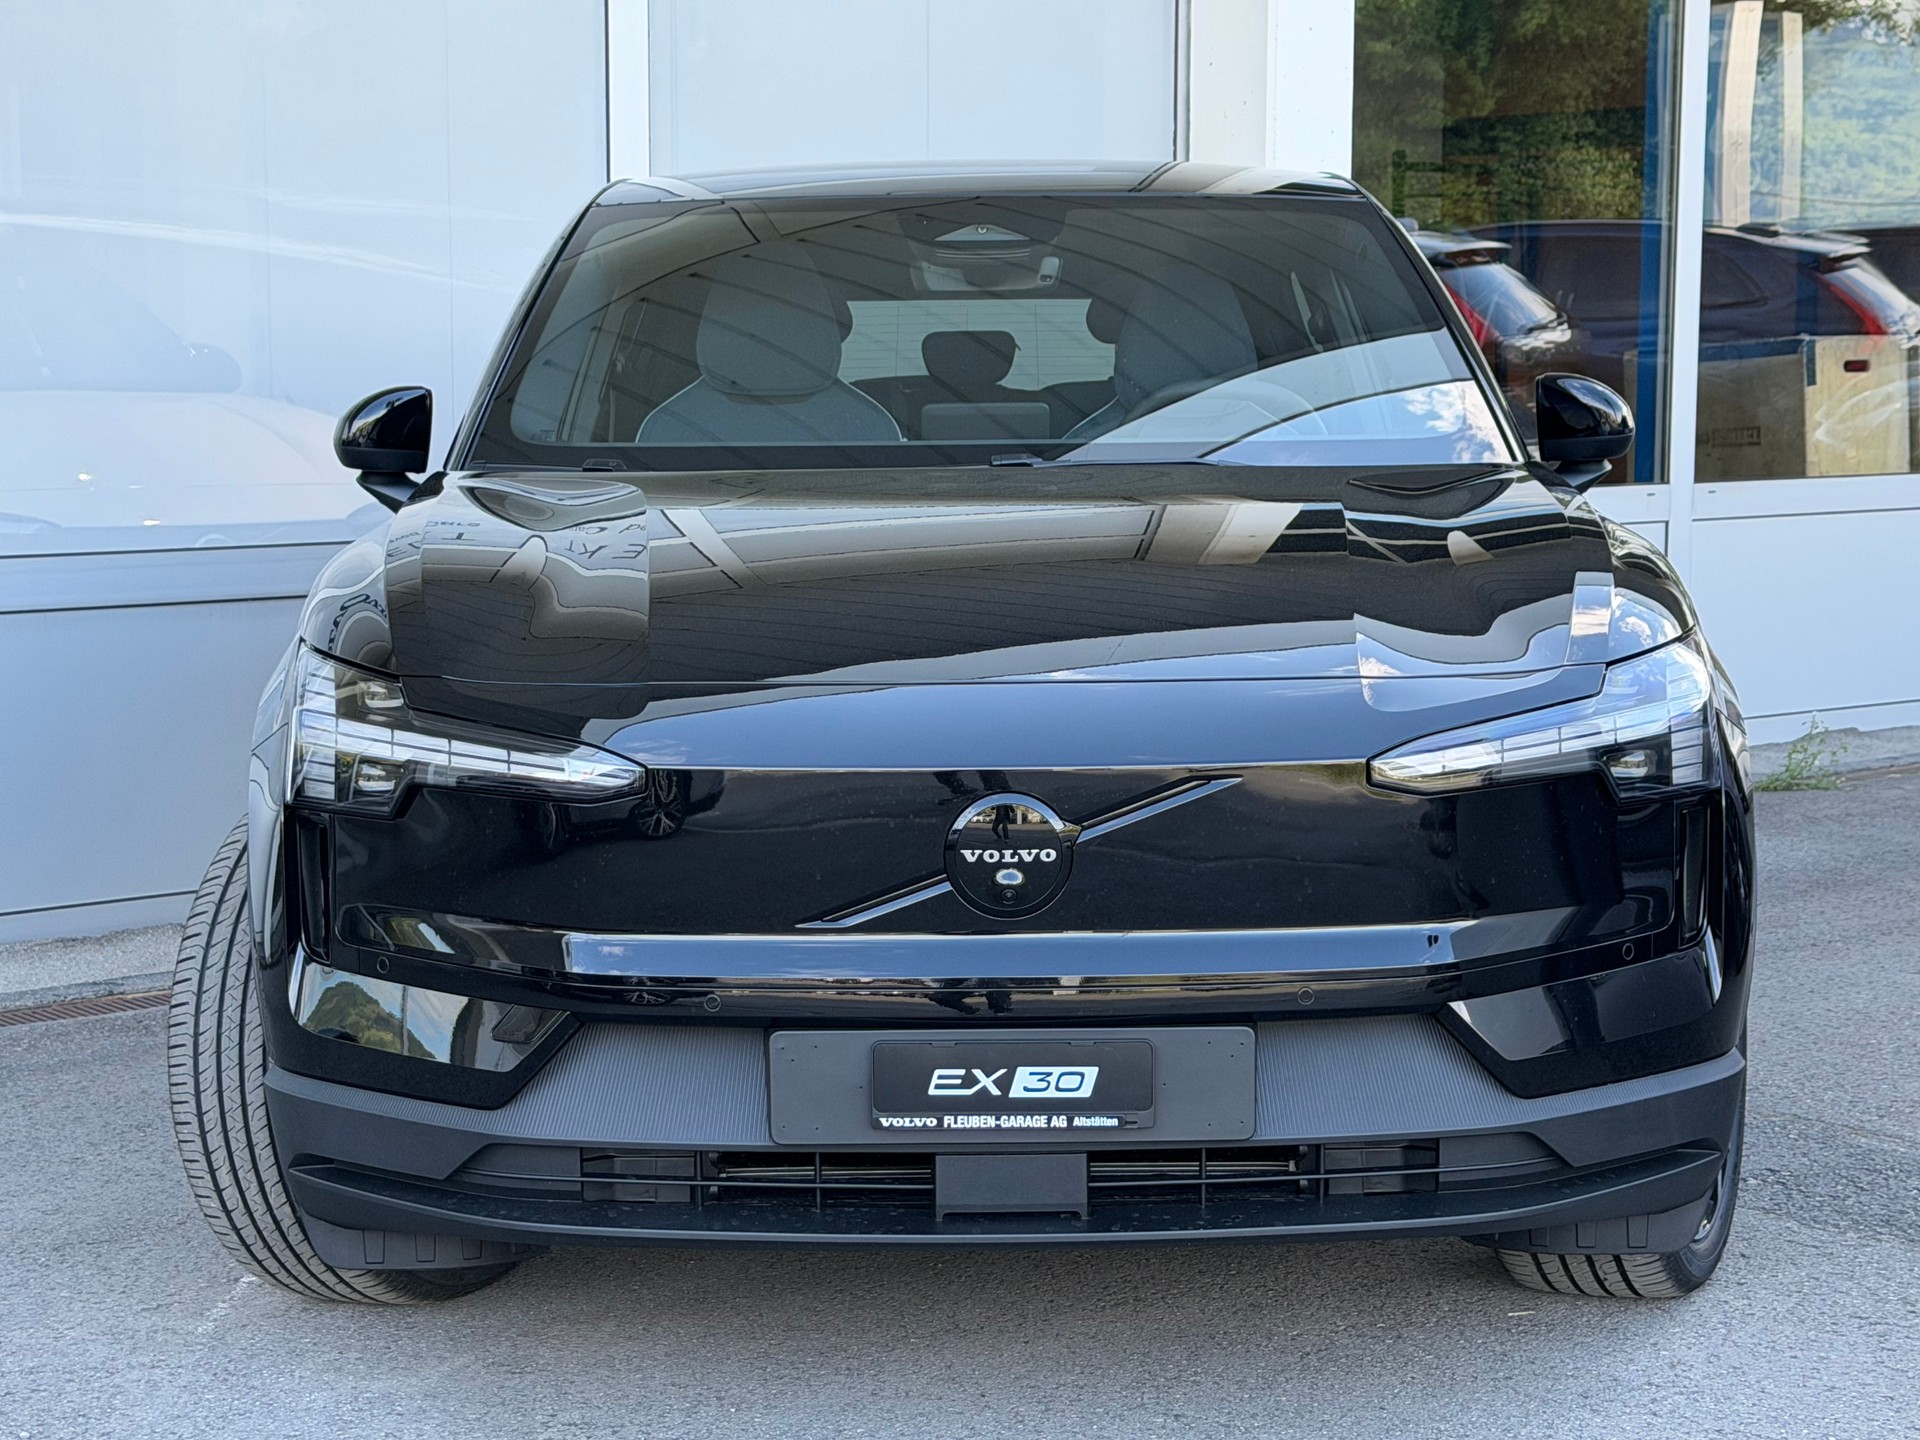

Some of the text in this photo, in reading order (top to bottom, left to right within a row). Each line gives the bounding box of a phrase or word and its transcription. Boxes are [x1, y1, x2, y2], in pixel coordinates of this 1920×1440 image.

[960, 849, 1057, 863] VOLVO
[928, 1068, 1086, 1095] EX 30
[879, 1115, 1119, 1128] VOLVO FLEUBEN-GARAGE AG Altstätten
